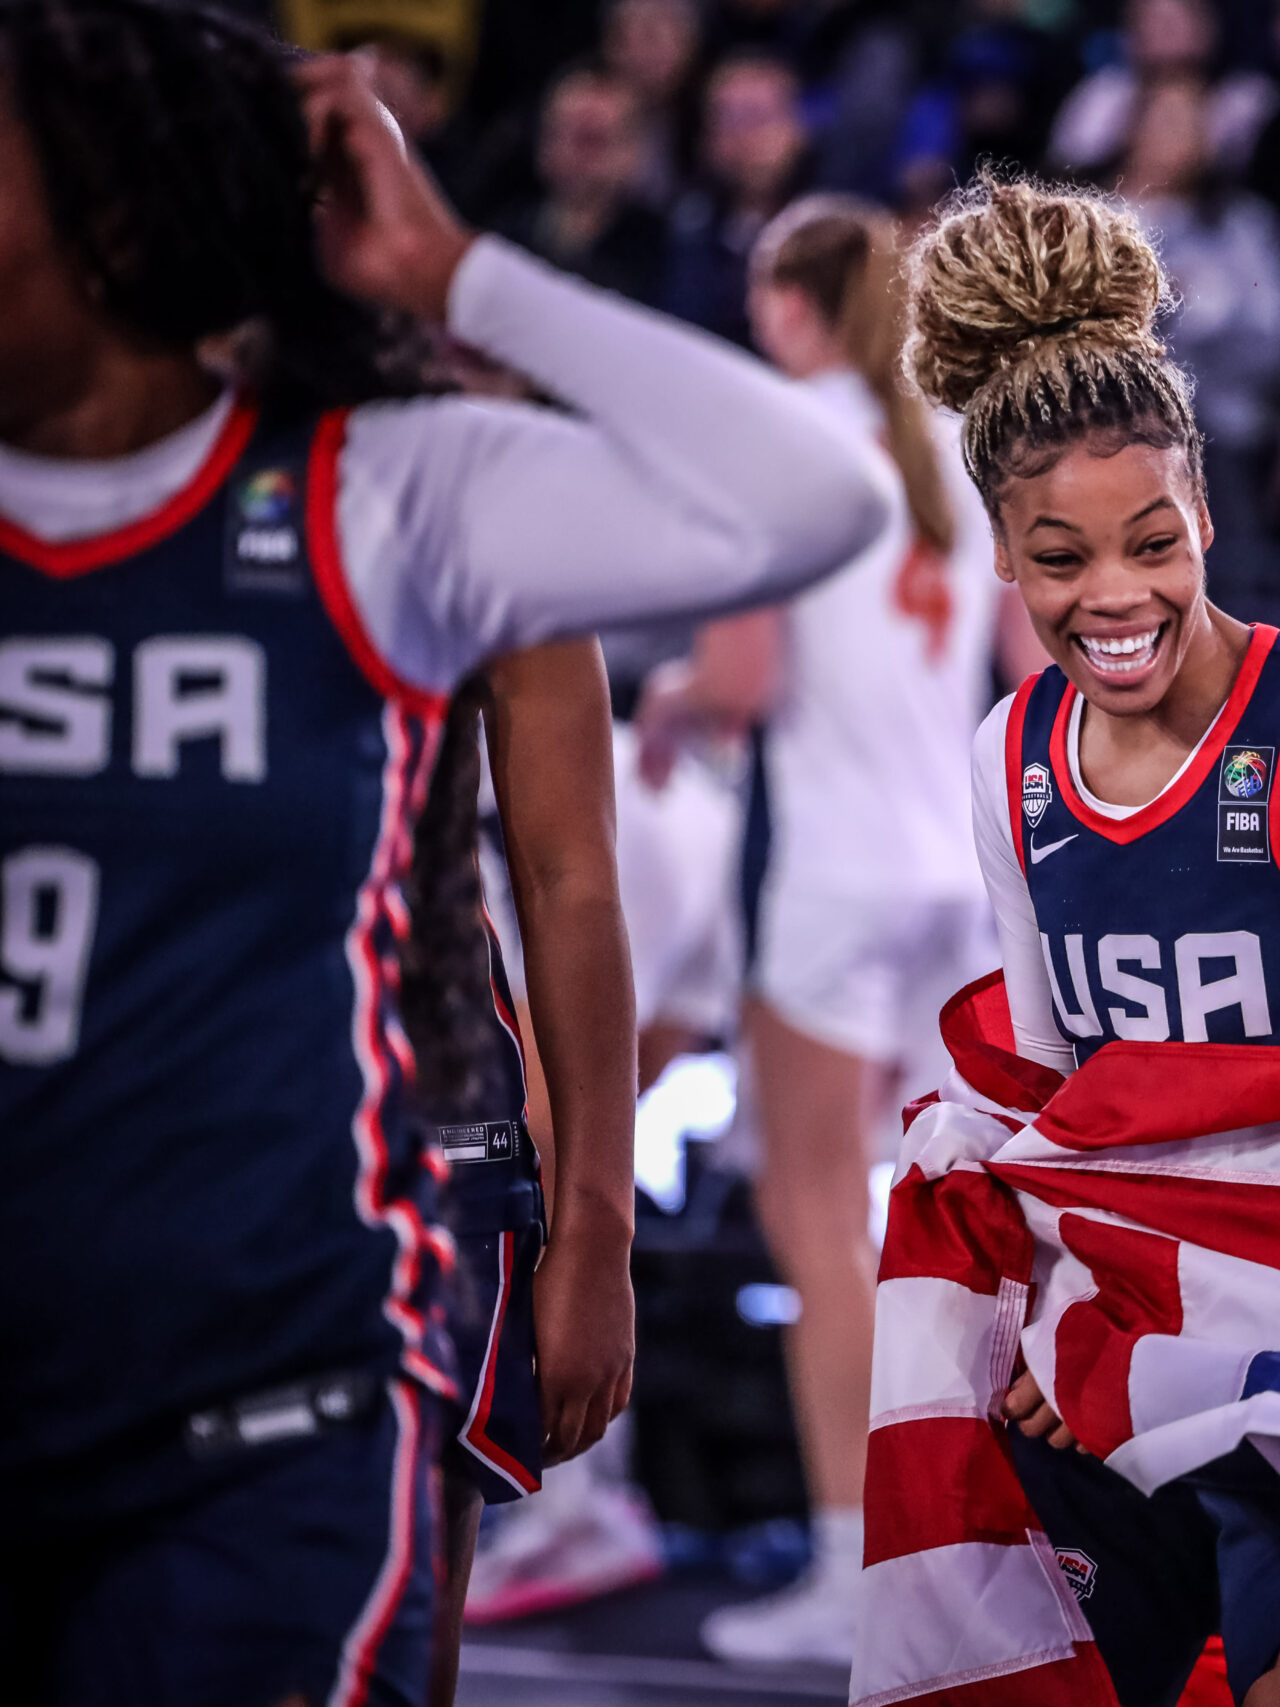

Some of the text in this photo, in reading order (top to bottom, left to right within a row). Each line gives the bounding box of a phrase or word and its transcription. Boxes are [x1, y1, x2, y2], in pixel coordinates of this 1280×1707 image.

[1226, 812, 1260, 831] FIBA
[0, 844, 101, 1067] 9
[1039, 930, 1273, 1043] USA
[492, 1131, 508, 1149] 44
